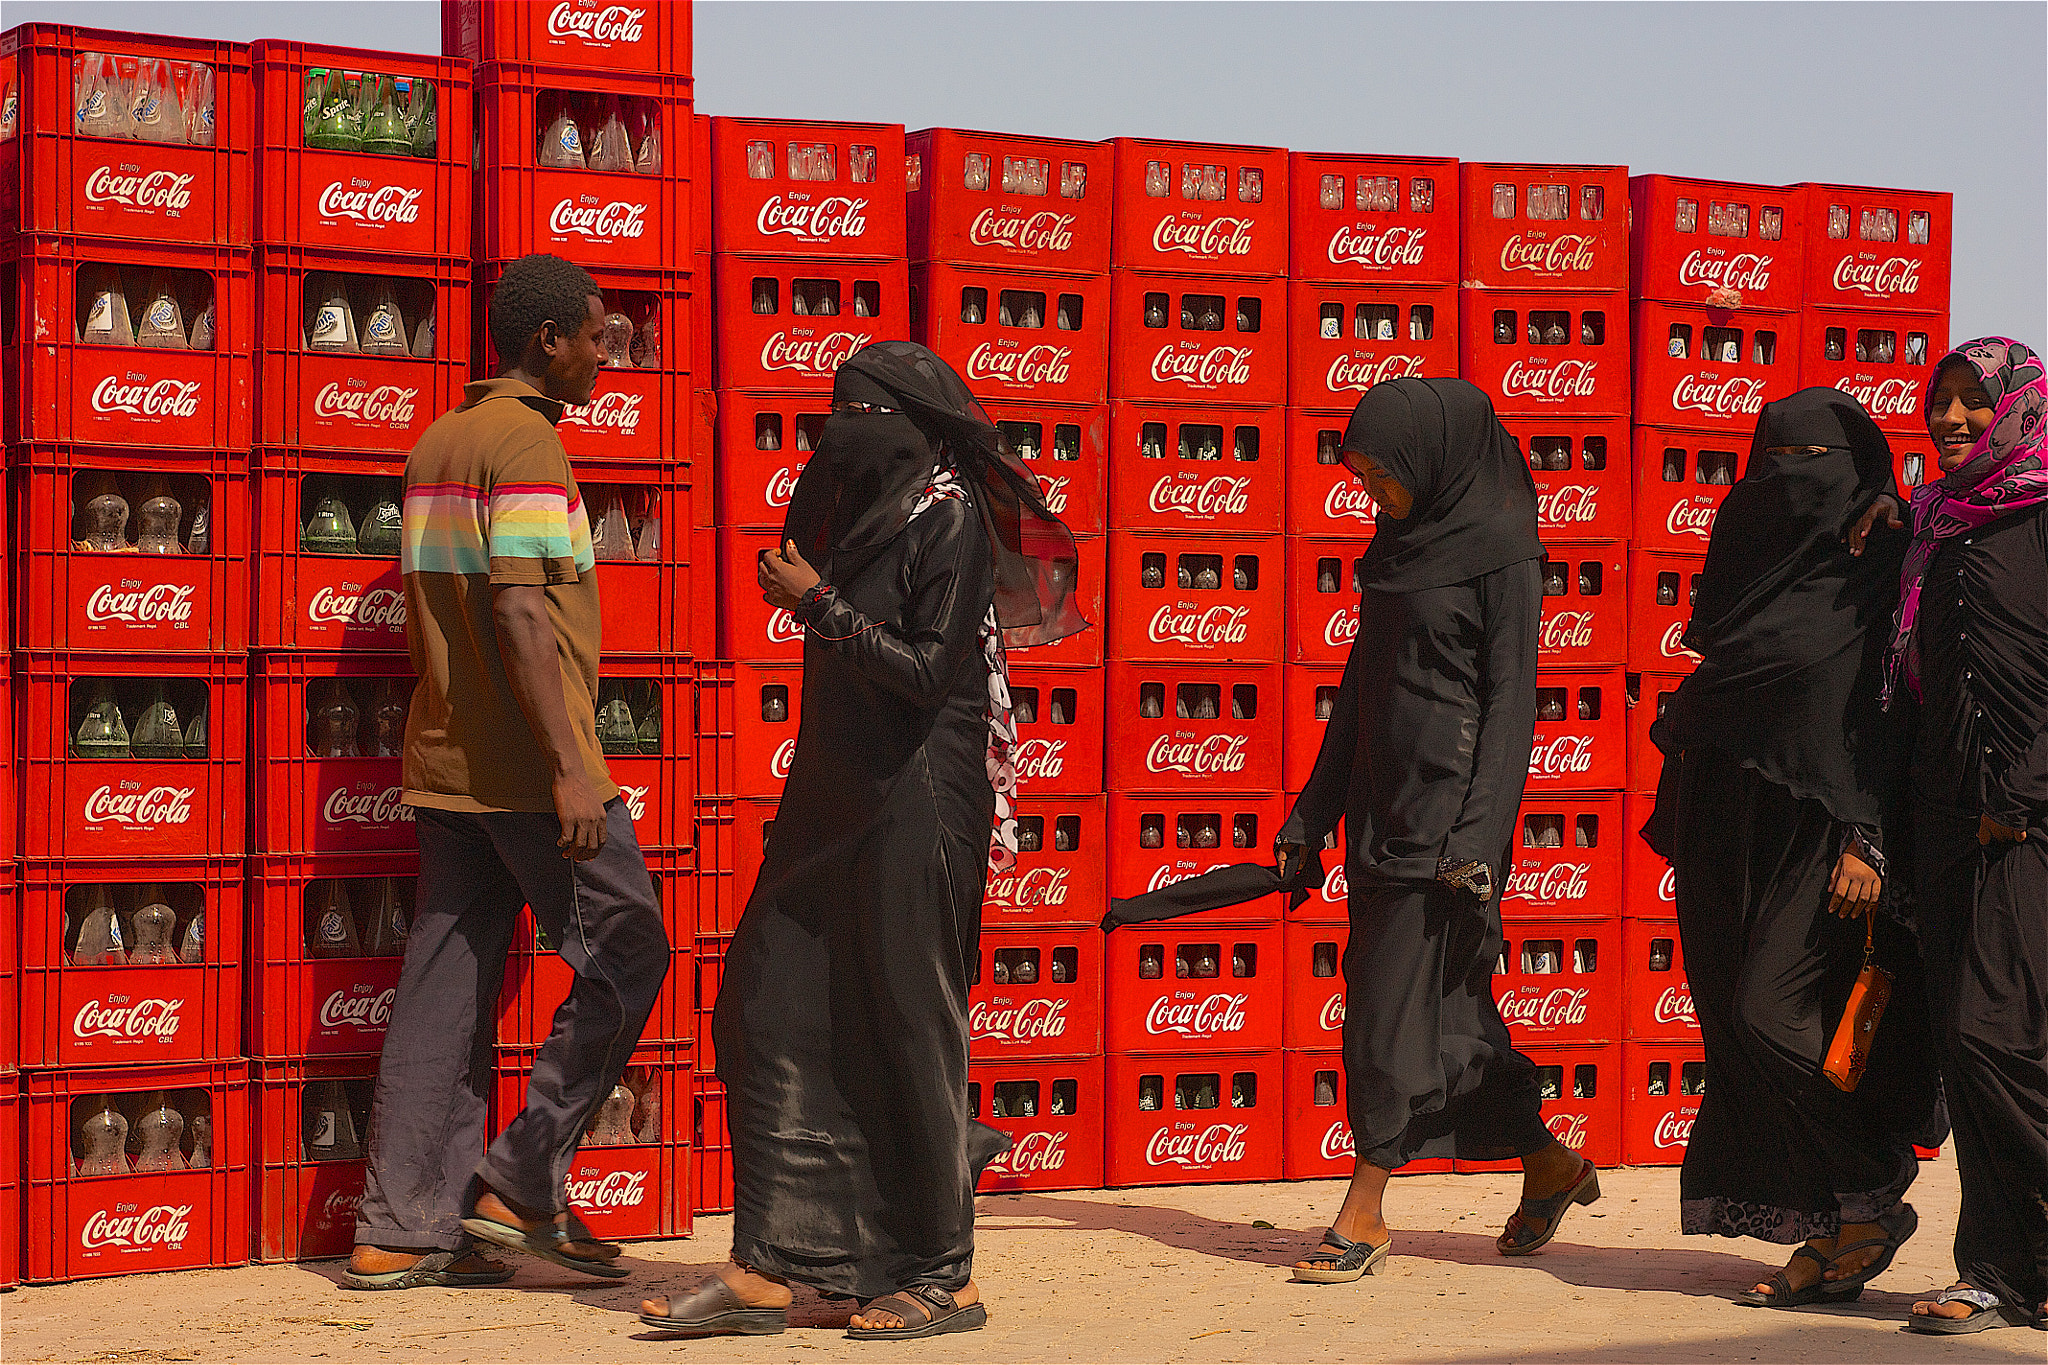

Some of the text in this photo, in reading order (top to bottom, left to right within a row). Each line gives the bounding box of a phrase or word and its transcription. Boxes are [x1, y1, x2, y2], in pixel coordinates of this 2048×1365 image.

[548, 0, 646, 42] Coca-Cola
[120, 163, 140, 173] Enjoy
[86, 167, 194, 209] Coca-Cola
[351, 177, 371, 188] Enjoy
[319, 179, 422, 223] Coca-Cola
[580, 194, 599, 205] Enjoy
[789, 192, 810, 201] Enjoy
[550, 196, 647, 237] Coca-Cola
[757, 196, 868, 236] Coca-Cola
[1001, 205, 1021, 214] Enjoy
[1182, 211, 1202, 220] Enjoy
[970, 208, 1076, 250] Coca-Cola
[1153, 216, 1254, 254] Coca-Cola
[1527, 231, 1546, 240] Enjoy
[1328, 227, 1426, 264] Coca-Cola
[1501, 235, 1596, 271] Coca-Cola
[1707, 247, 1725, 256] Enjoy
[1859, 252, 1877, 261] Enjoy
[1680, 250, 1773, 290] Coca-Cola
[1833, 254, 1922, 293] Coca-Cola
[793, 328, 814, 337] Enjoy
[998, 339, 1019, 348] Enjoy
[761, 332, 872, 372] Coca-Col
[967, 343, 1070, 383] Coca-Cola
[1355, 351, 1374, 360] Enjoy
[1529, 357, 1548, 366] Enjoy
[1151, 345, 1252, 384] Coca-Cola
[1700, 371, 1718, 380] Enjoy
[126, 371, 147, 382] Enjoy
[348, 378, 367, 388] Enjoy
[1502, 360, 1597, 396] Coca-Cola
[1856, 374, 1873, 383] Enjoy
[92, 376, 200, 417] Coca-Cola
[315, 382, 418, 422] Coca-Cola
[1673, 375, 1766, 414] Coca-Cola
[1178, 472, 1198, 481] Enjoy
[1150, 476, 1251, 513] Coca-Cola
[1695, 496, 1713, 505] Enjoy
[121, 578, 142, 589] Enjoy
[347, 581, 368, 592] Enjoy
[87, 584, 195, 621] Coca-Cola
[309, 587, 411, 626] Coca-Cola
[1178, 601, 1198, 610] Enjoy
[1149, 606, 1249, 642] Coca-Cola
[1176, 730, 1195, 739] Enjoy
[1147, 735, 1248, 772] Coca-Cola
[1528, 736, 1593, 773] a-Cola
[120, 780, 141, 790] Enjoy
[85, 786, 195, 823] Coca-Cola
[1177, 861, 1197, 870] Enjoy
[1522, 860, 1541, 869] Enjoy
[1501, 863, 1591, 900] oca-Cola
[109, 994, 130, 1004] Enjoy
[353, 984, 373, 993] Enjoy
[1175, 991, 1195, 1000] Enjoy
[1521, 986, 1540, 995] Enjoy
[74, 999, 184, 1037] Coca-Cola
[320, 989, 396, 1027] Coca-C
[1146, 991, 1248, 1034] Coca-Cola
[968, 999, 1068, 1042] Coca-Cola
[1175, 1122, 1195, 1131] Enjoy
[1146, 1124, 1248, 1165] Coca-Cola
[581, 1167, 600, 1177] Enjoy
[565, 1171, 648, 1208] oca-Cola
[116, 1203, 137, 1212] Enjoy
[82, 1204, 192, 1249] Coca-Cola
